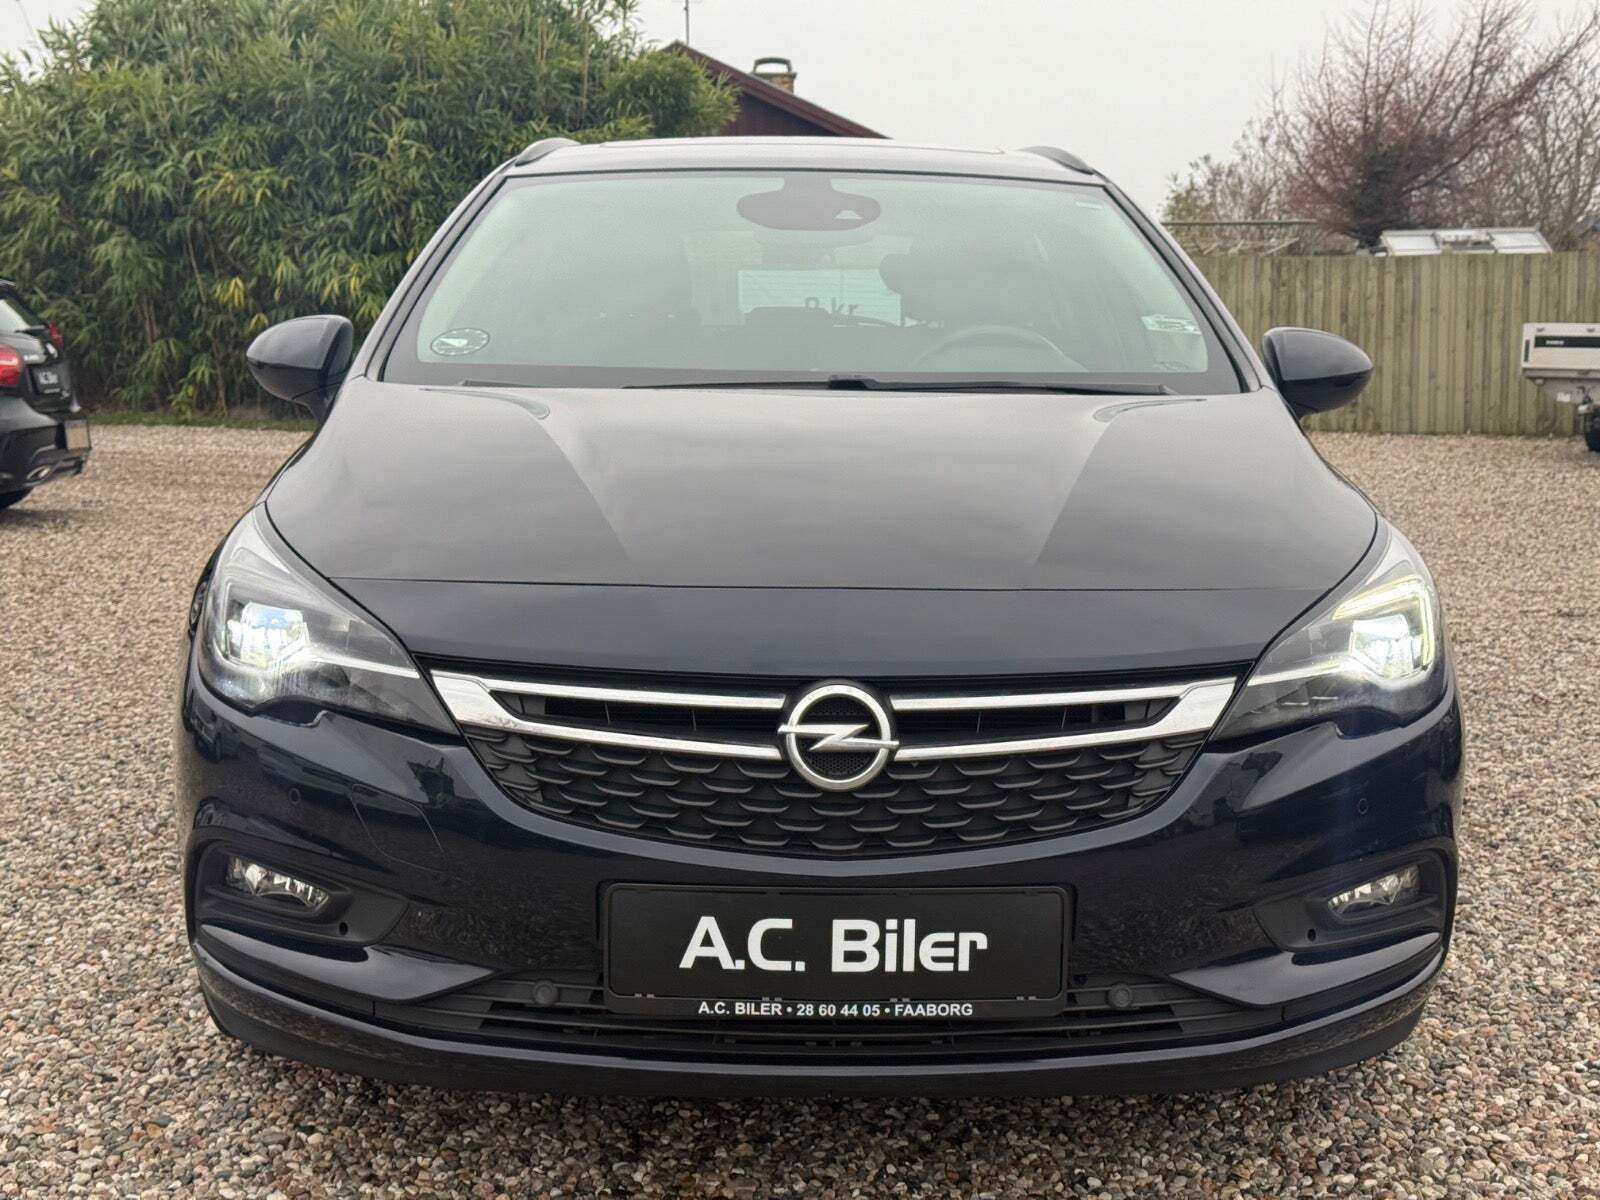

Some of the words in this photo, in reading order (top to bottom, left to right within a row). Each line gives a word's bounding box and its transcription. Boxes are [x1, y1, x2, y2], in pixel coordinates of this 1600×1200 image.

[679, 916, 806, 972] A.C.
[831, 918, 988, 973] Biler
[698, 1001, 731, 1015] A.C.
[735, 1002, 783, 1016] BILER
[796, 1003, 815, 1017] 28
[818, 1003, 837, 1017] 60
[840, 1003, 859, 1017] 44
[862, 1003, 881, 1017] 05
[894, 1003, 973, 1017] FAABORG
